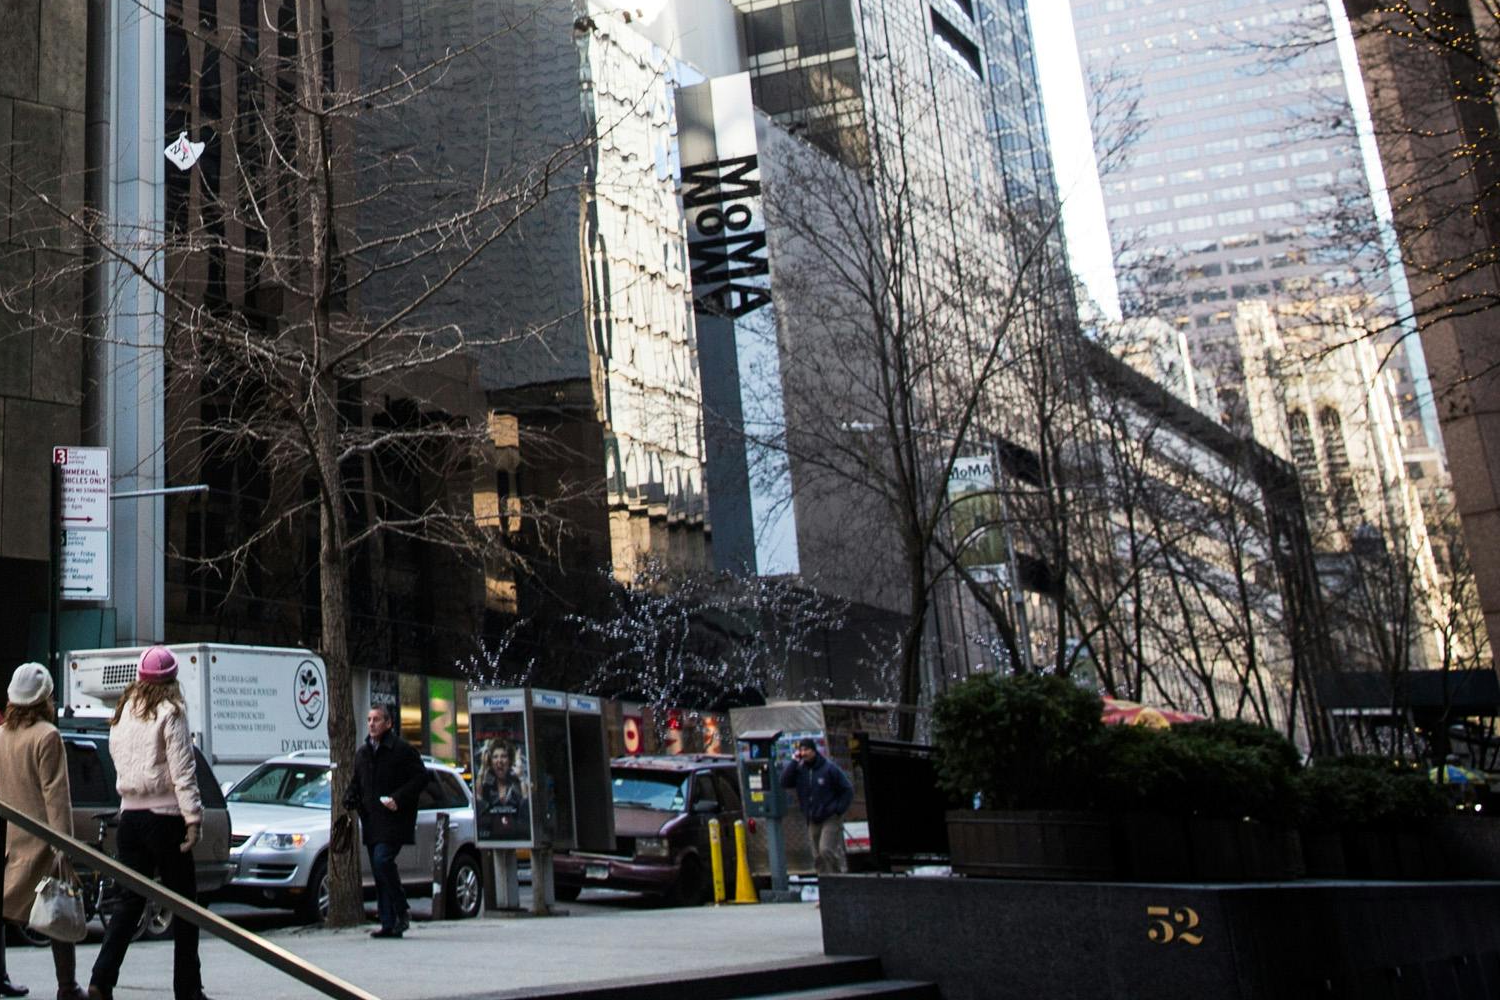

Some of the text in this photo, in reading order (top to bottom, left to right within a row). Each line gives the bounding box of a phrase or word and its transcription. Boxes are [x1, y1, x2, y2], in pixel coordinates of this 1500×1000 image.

[719, 154, 772, 318] MoMA
[57, 450, 66, 464] 3
[60, 468, 99, 476] OMMERCIAL
[90, 477, 106, 485] ONLY
[483, 696, 510, 706] Phone
[281, 738, 329, 753] D'ARTAGN
[1147, 906, 1204, 946] 52
